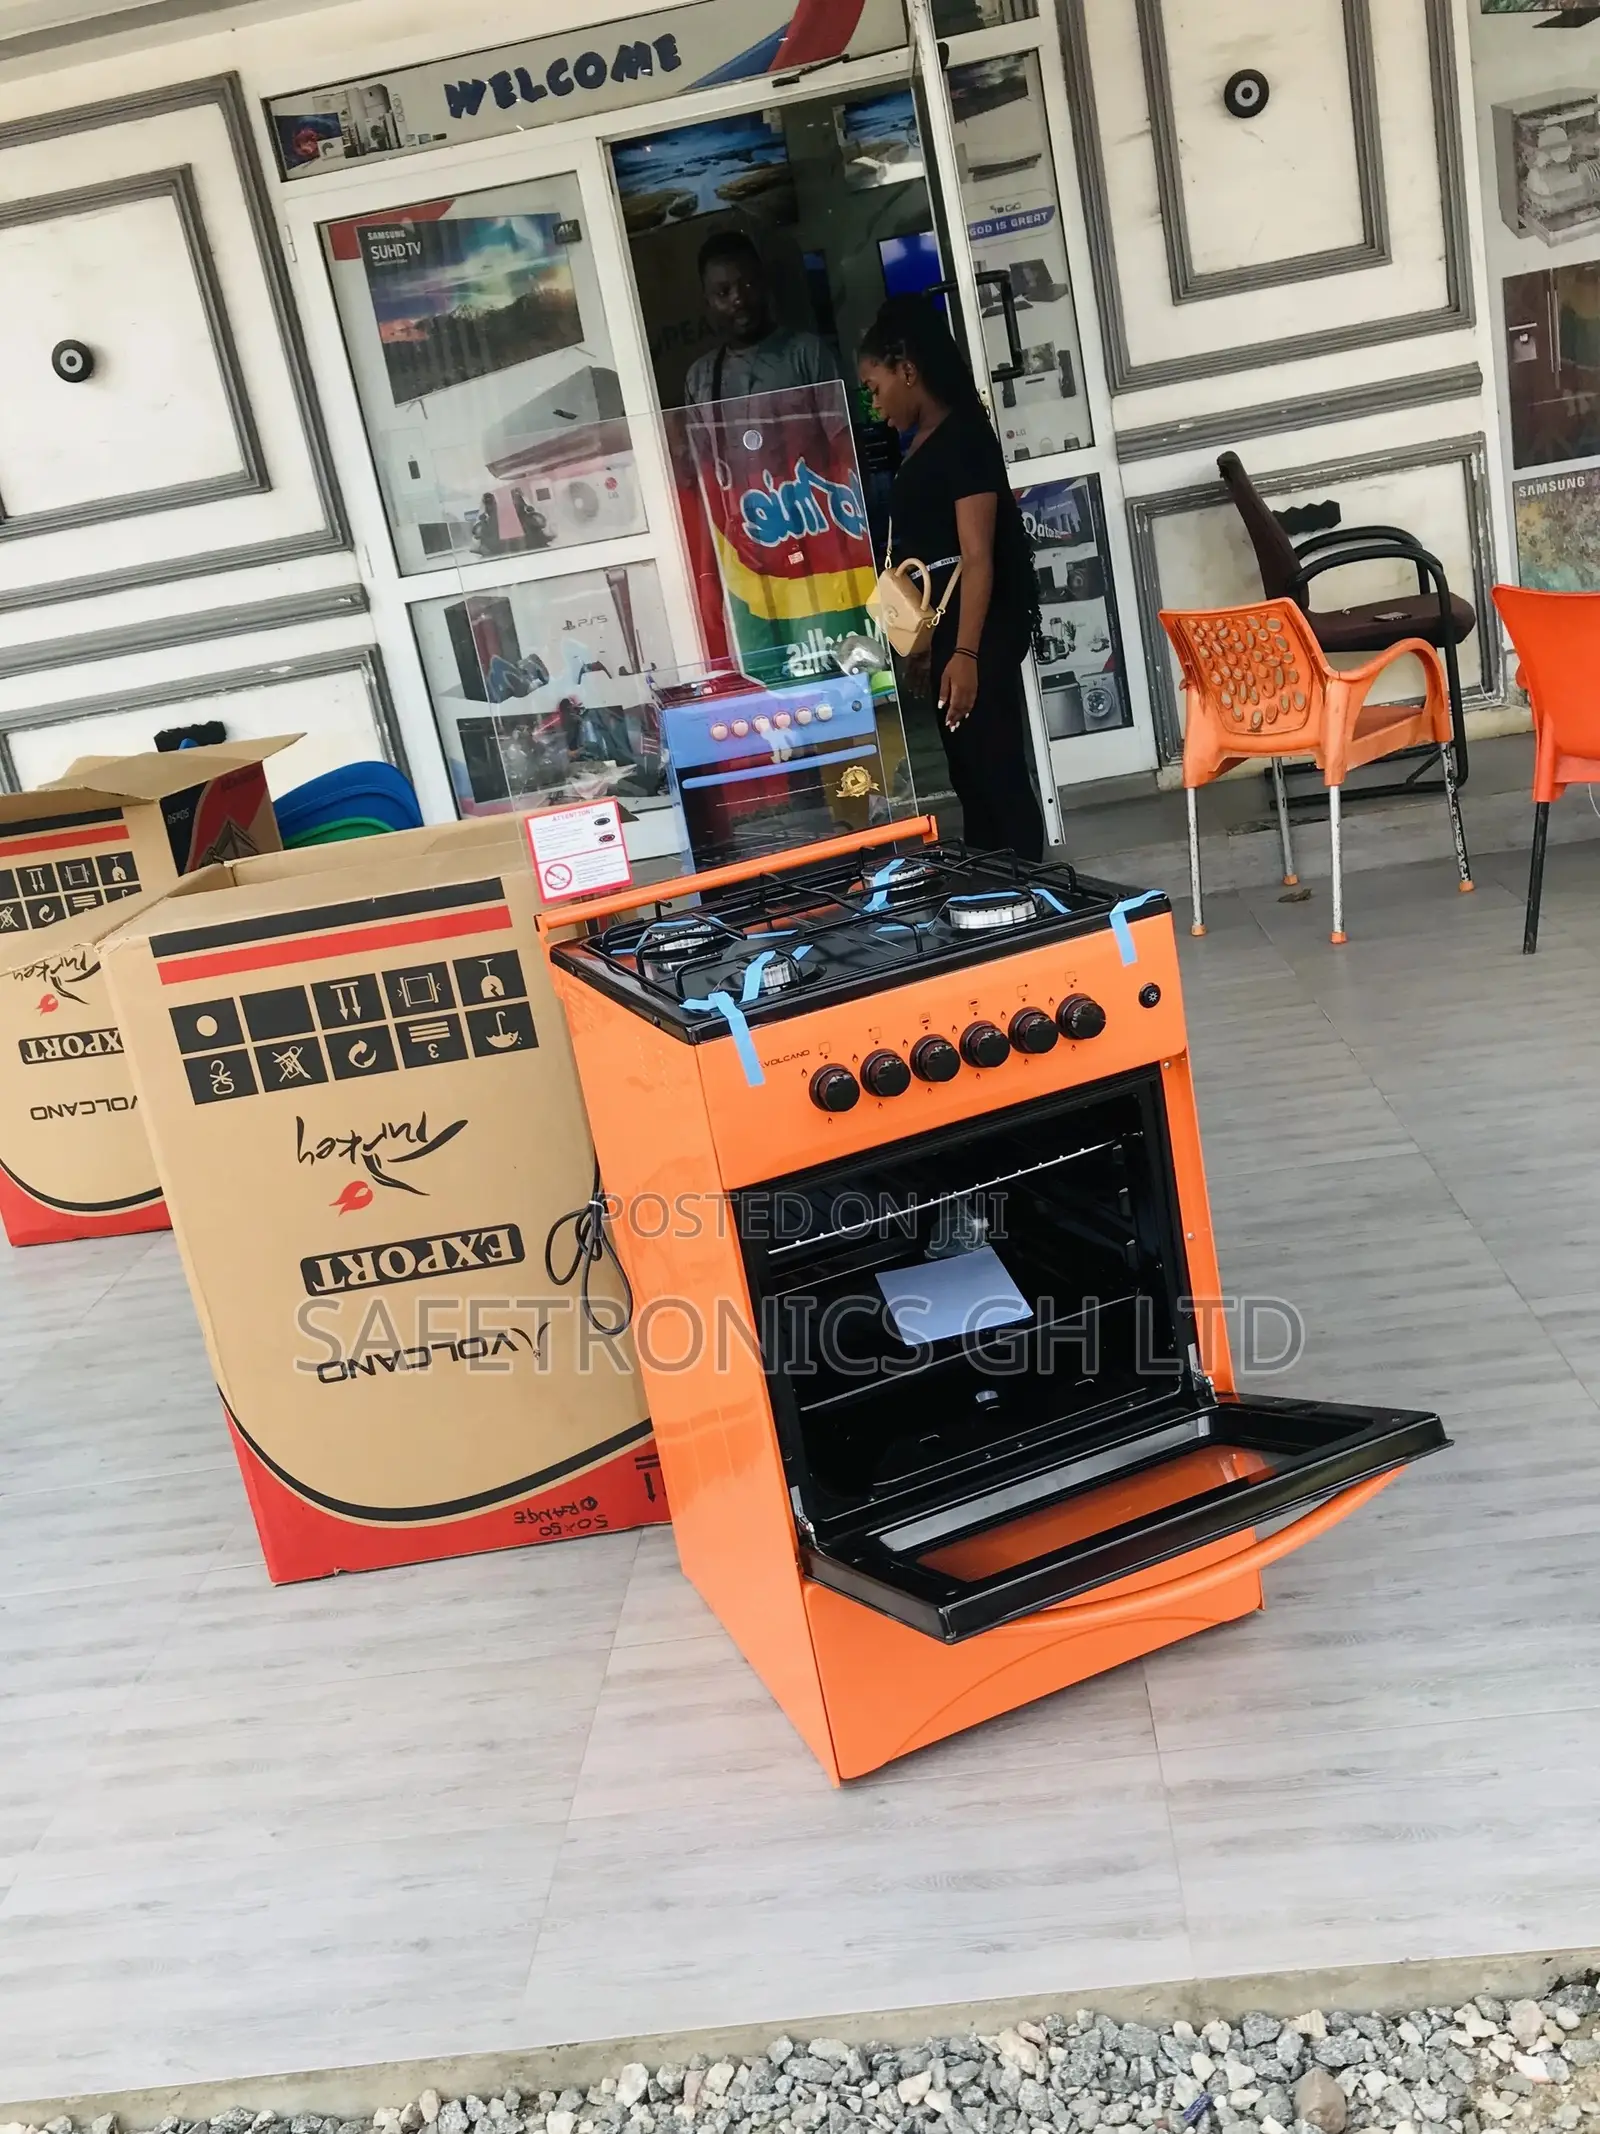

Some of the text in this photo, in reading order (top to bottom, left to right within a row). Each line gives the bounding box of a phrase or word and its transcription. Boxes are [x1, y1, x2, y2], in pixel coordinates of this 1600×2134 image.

[443, 33, 682, 119] WELCOME
[367, 230, 406, 240] SAMSUNG
[969, 211, 1048, 236] GOD IS GREAT
[370, 241, 421, 260] SUHD TV
[1518, 476, 1585, 498] SAMSUNG
[578, 614, 608, 628] PS5
[25, 1029, 125, 1063] XPORT
[763, 1049, 811, 1068] VOLCANO
[311, 1226, 518, 1294] EXPORT
[316, 1331, 520, 1385] VOLCANO
